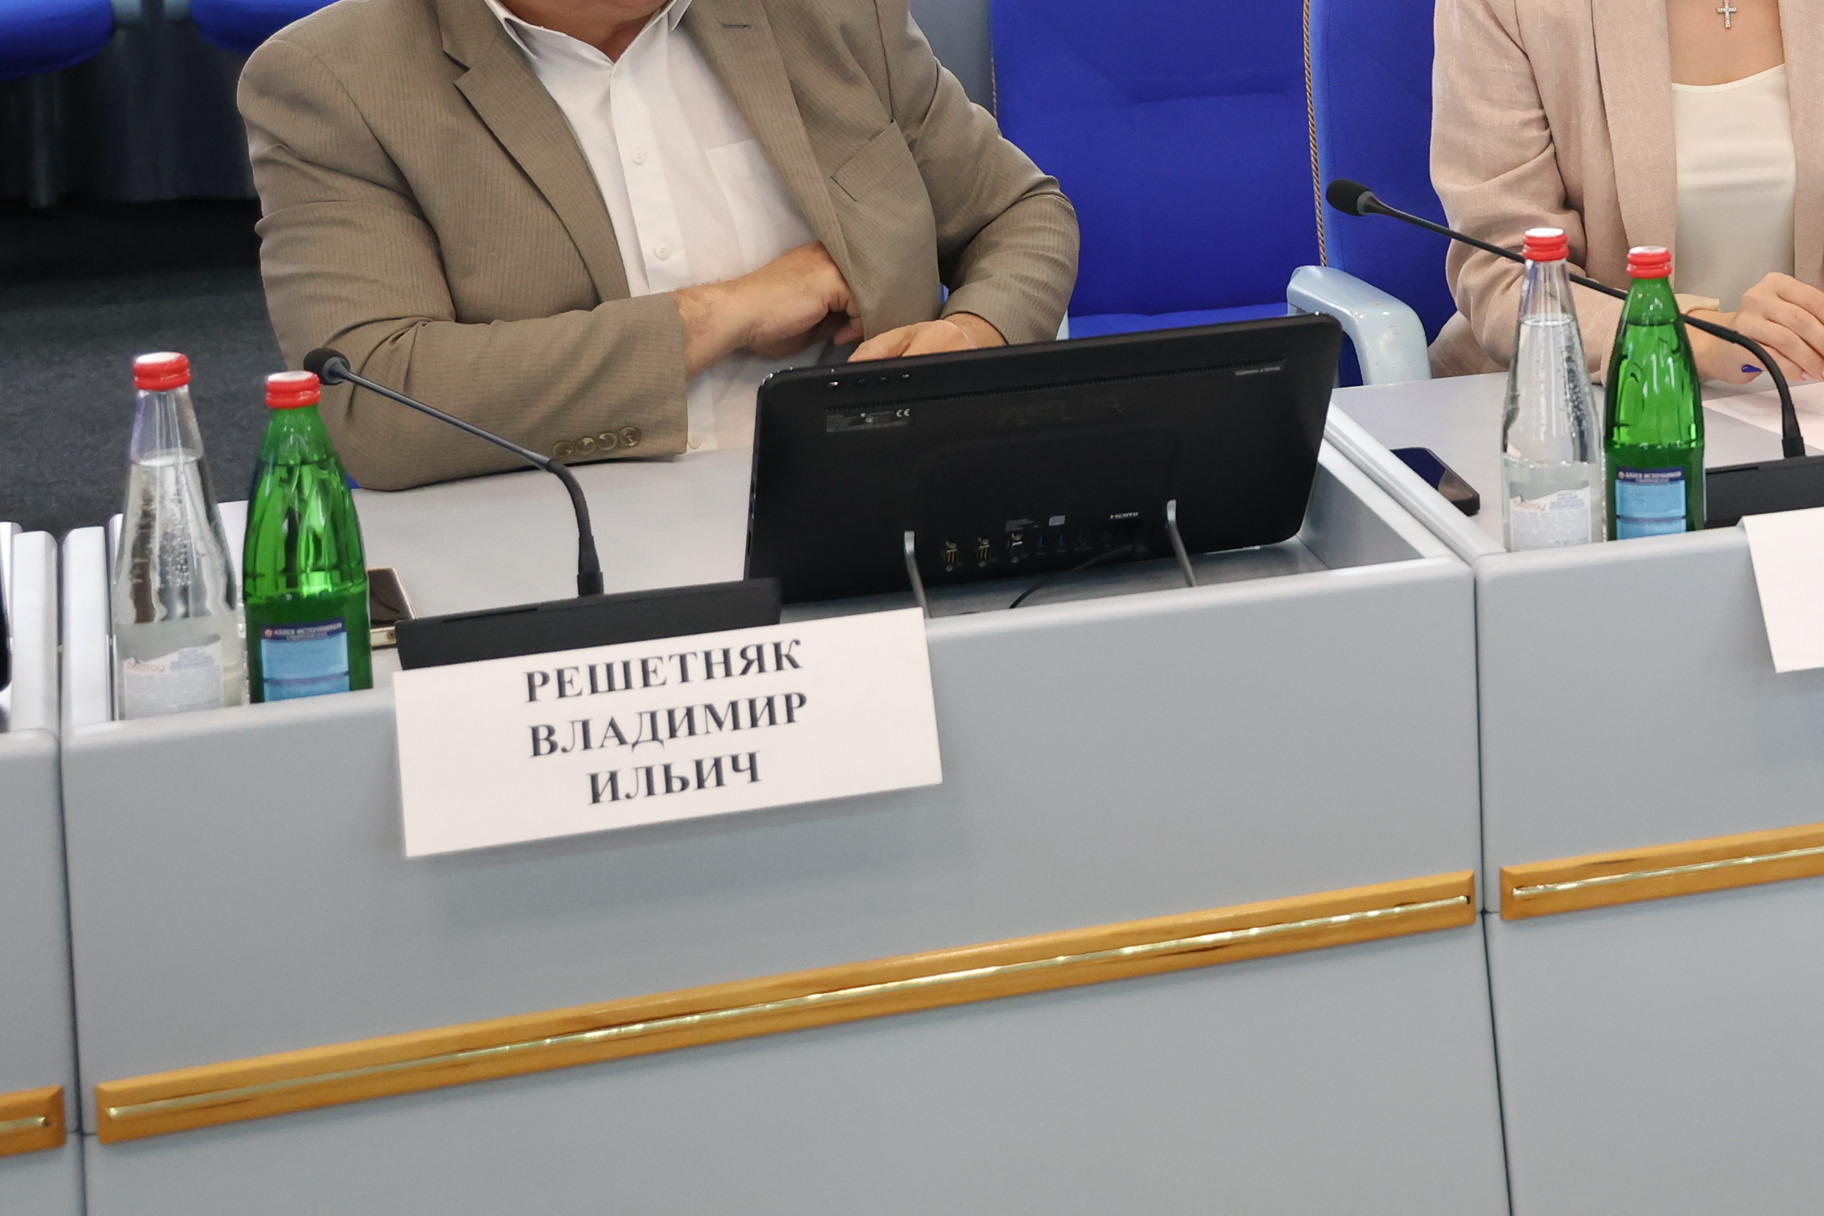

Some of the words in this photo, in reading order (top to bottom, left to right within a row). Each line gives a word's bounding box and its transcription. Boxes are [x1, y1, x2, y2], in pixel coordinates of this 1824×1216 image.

[525, 638, 803, 704] РЕШЕТНЯК
[528, 691, 808, 758] ВЛАДИМИР
[587, 751, 762, 806] ИЛЬИЧ
